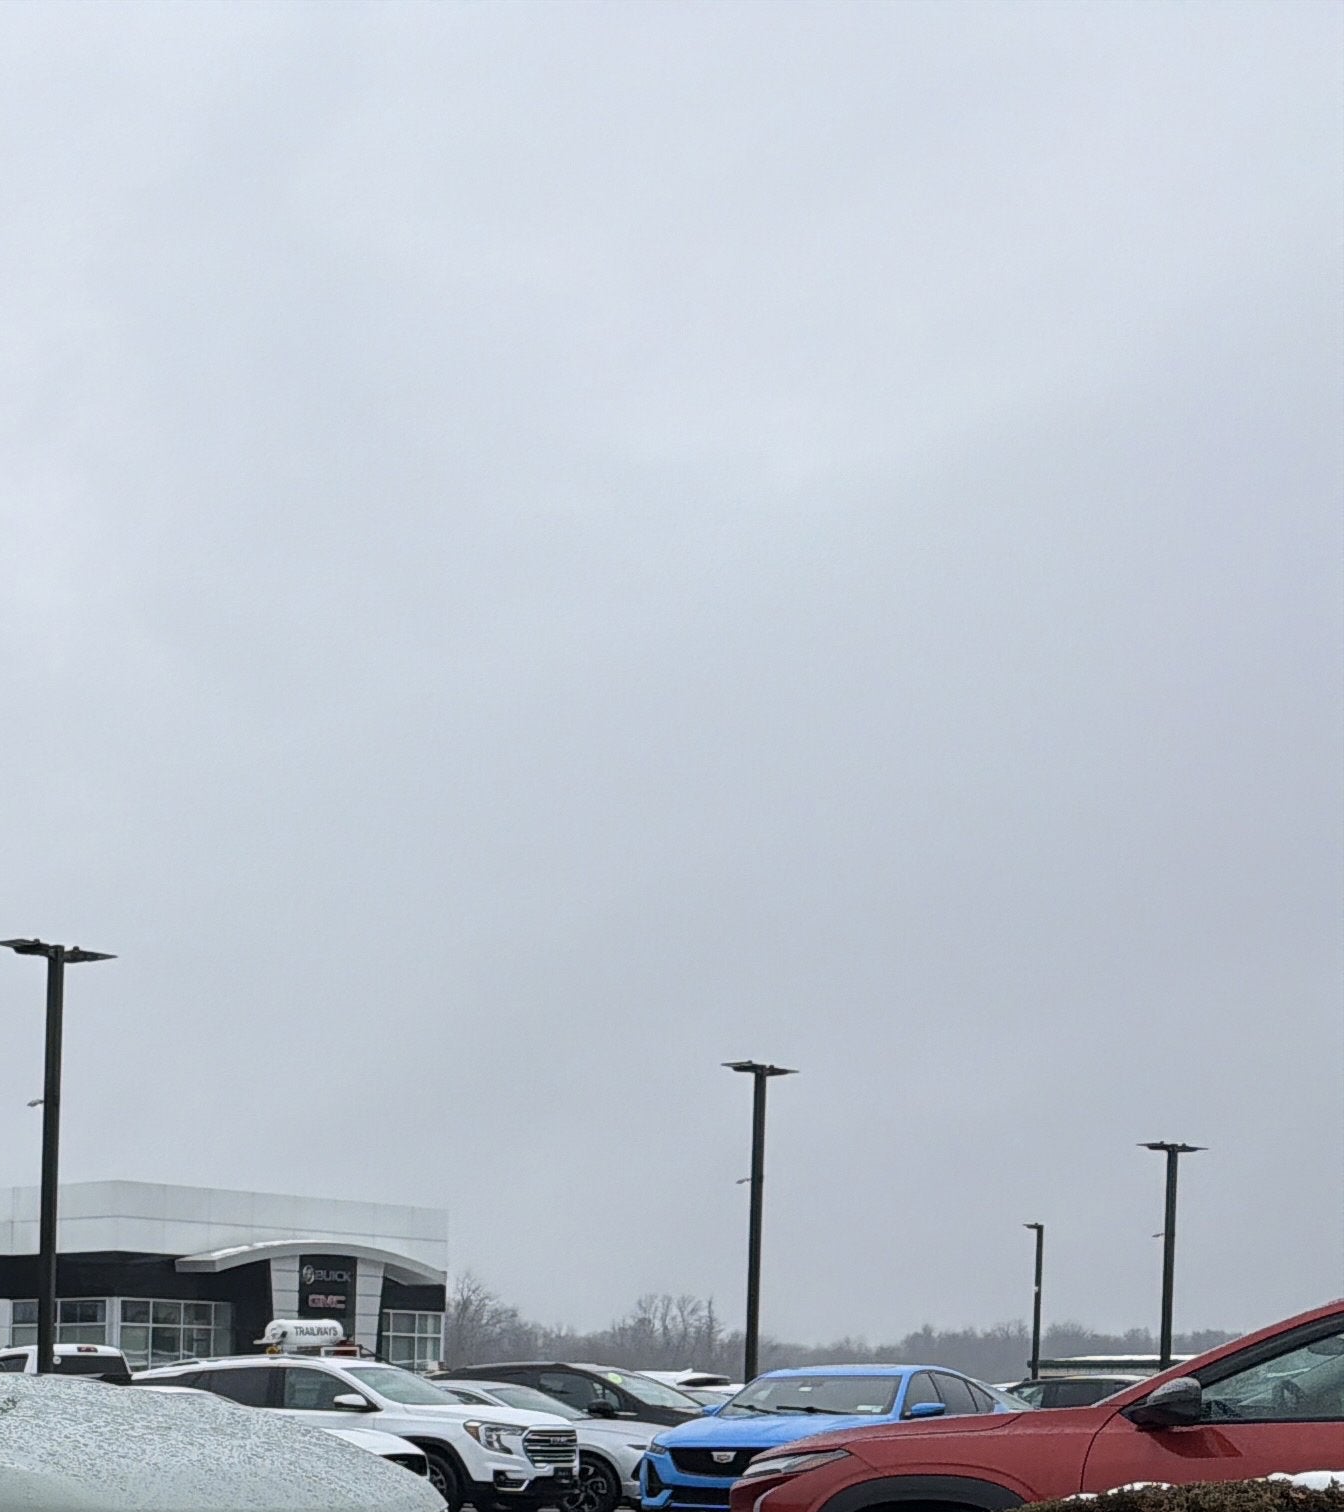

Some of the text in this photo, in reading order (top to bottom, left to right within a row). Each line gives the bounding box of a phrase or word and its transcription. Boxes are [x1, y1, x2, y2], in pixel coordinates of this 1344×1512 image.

[314, 1269, 352, 1281] BUICK
[308, 1294, 346, 1308] GMC
[294, 1326, 339, 1337] TRAILWAYS
